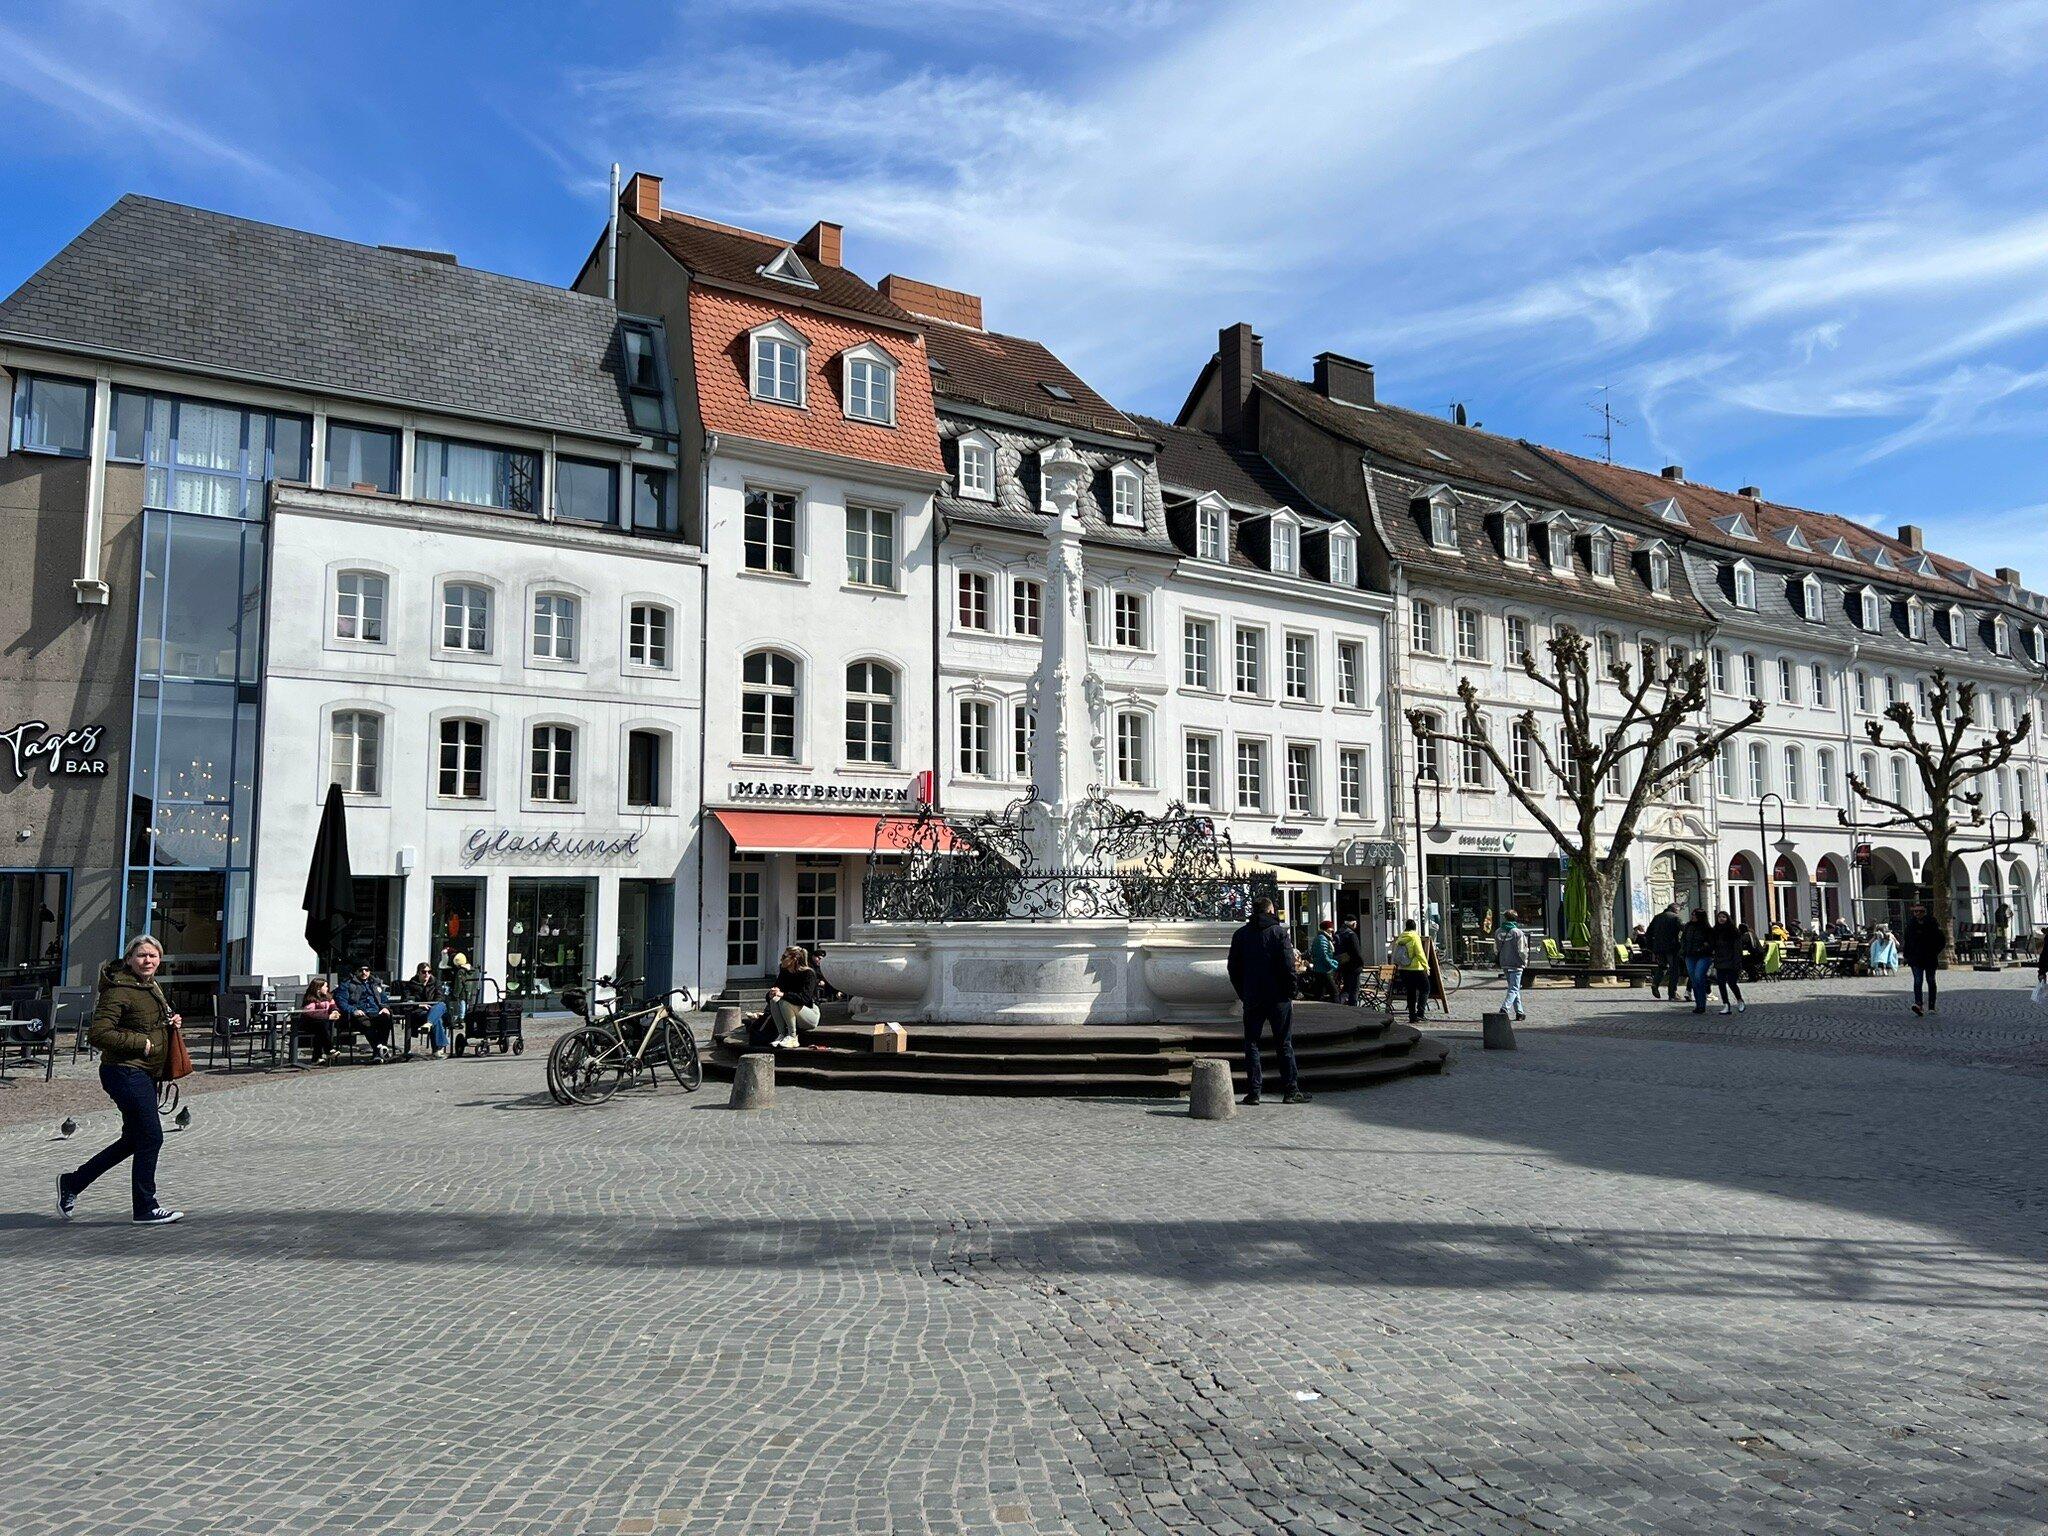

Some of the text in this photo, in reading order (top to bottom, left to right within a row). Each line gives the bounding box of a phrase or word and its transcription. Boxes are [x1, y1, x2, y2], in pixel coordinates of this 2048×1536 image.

[0, 722, 102, 777] Tages
[66, 760, 105, 773] BAR
[738, 781, 908, 800] MARKTBRUNNEN
[468, 828, 639, 861] Glaskunst
